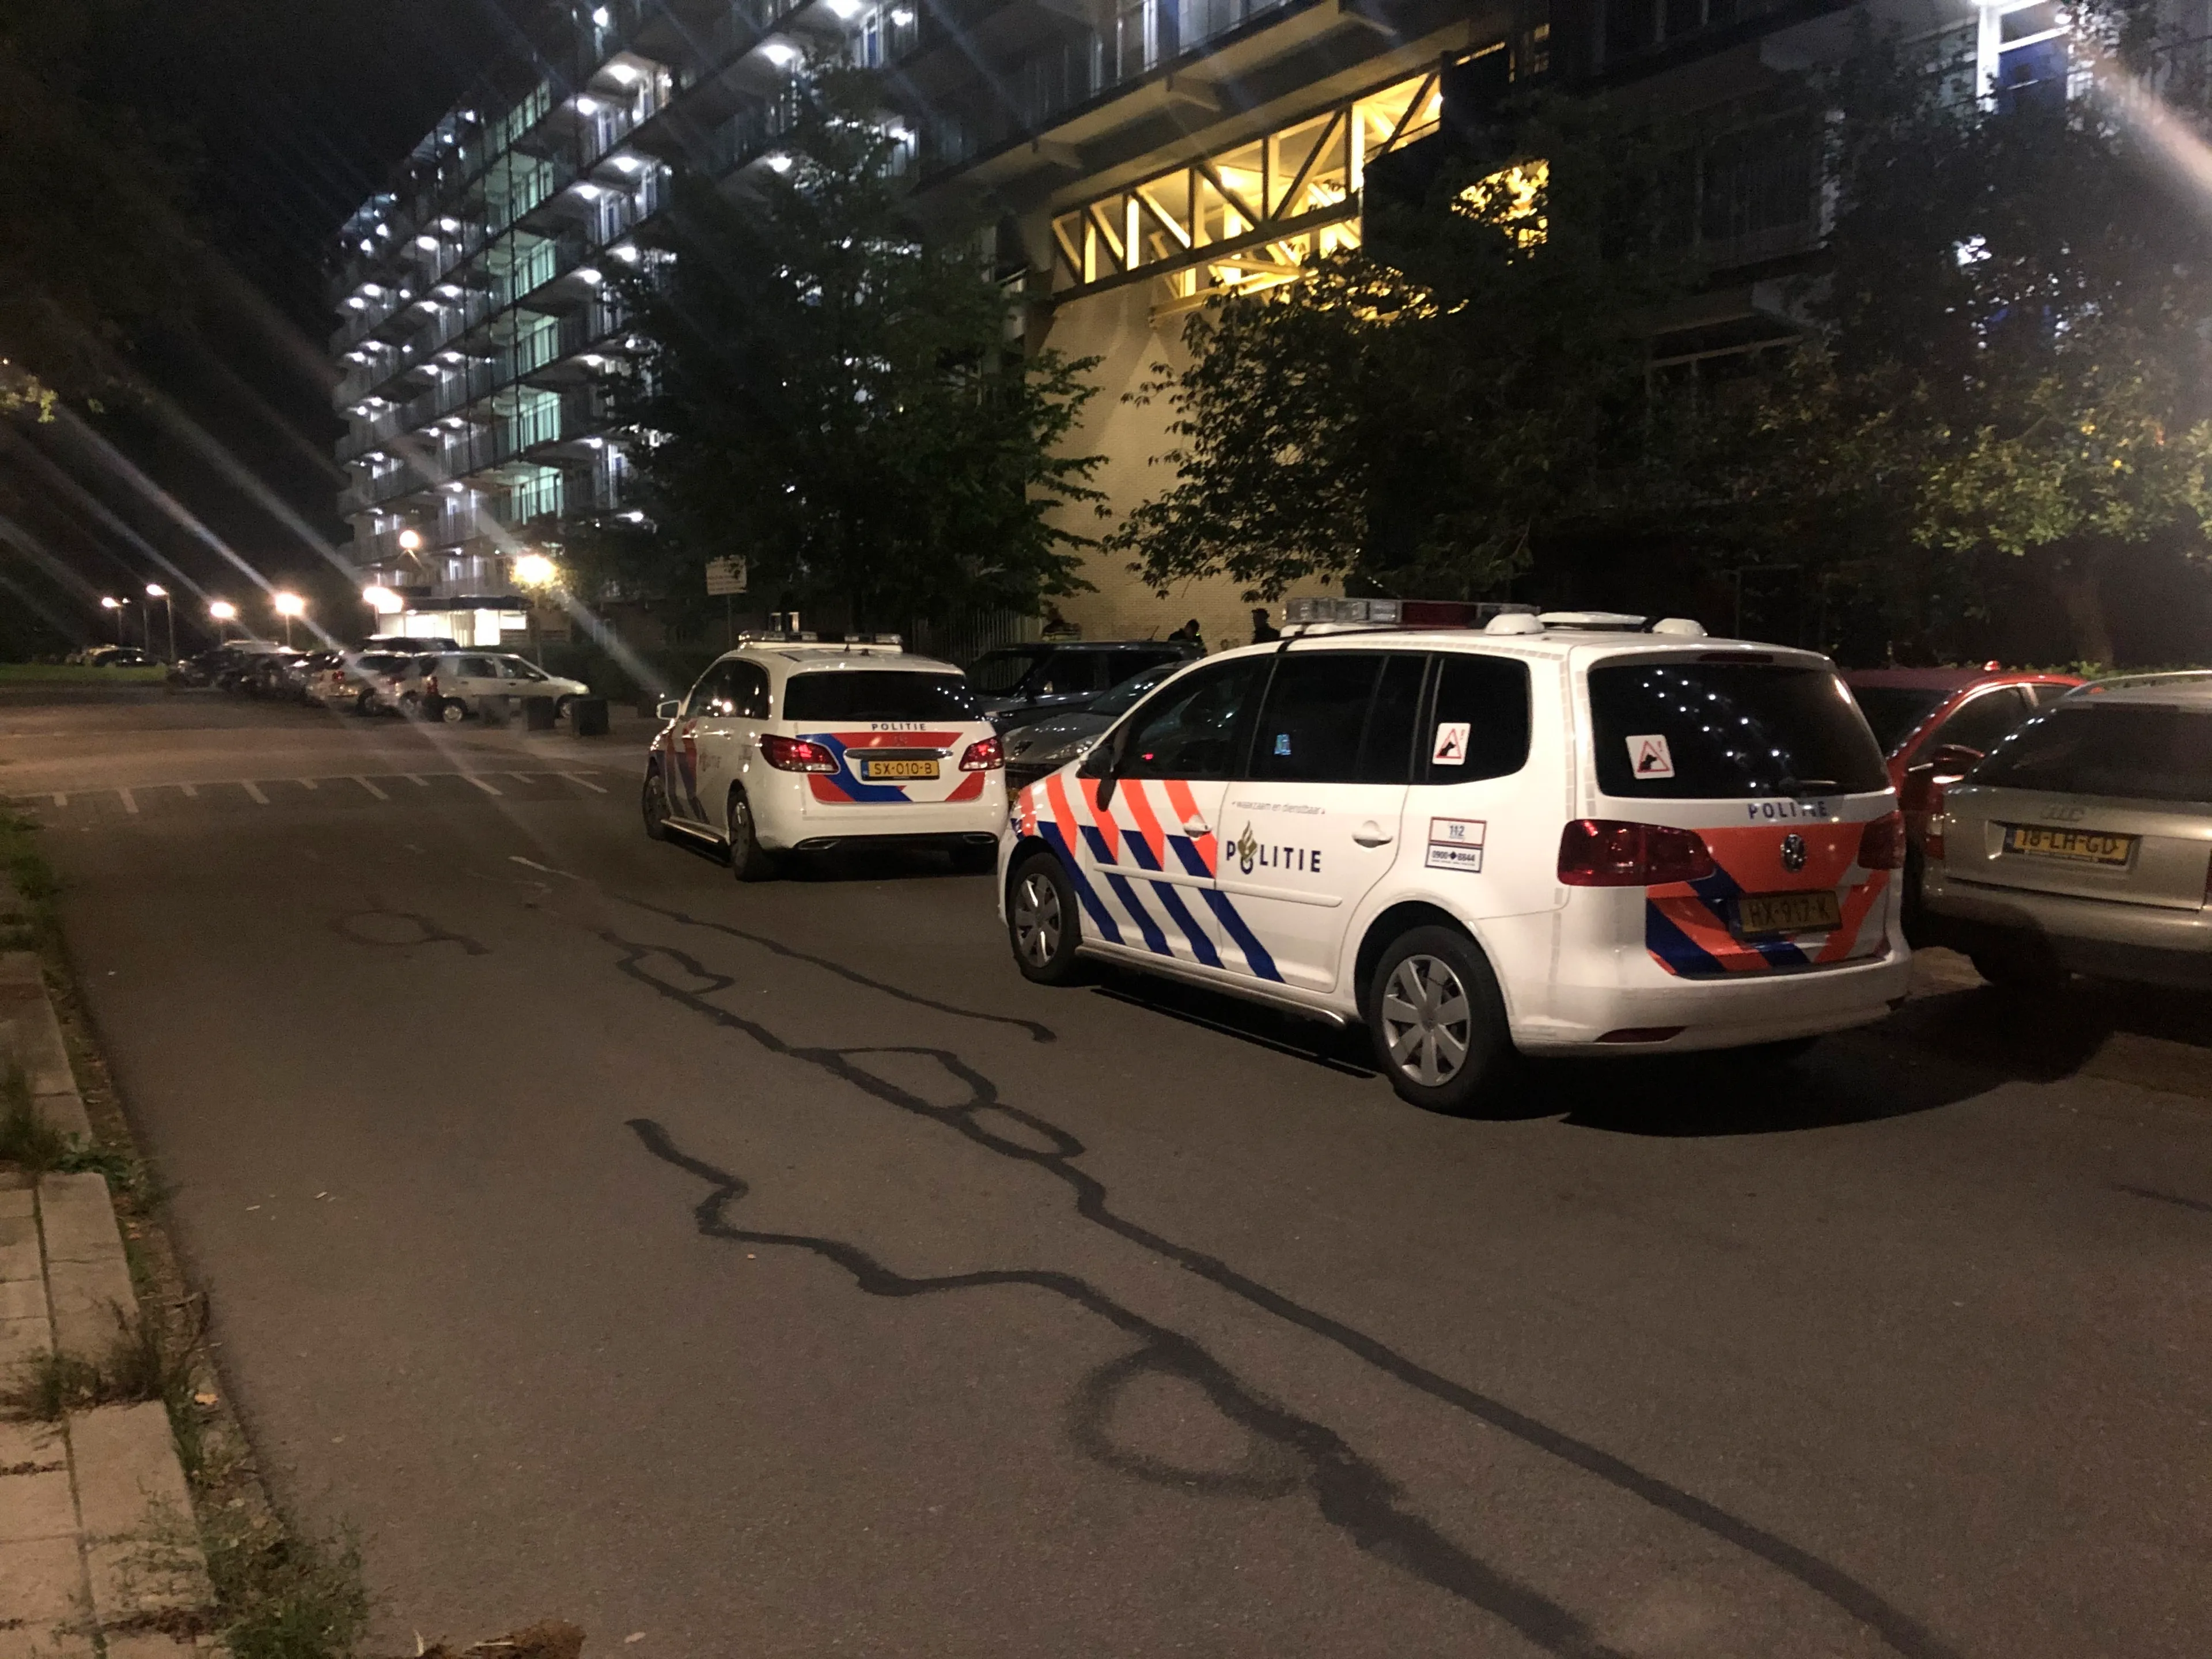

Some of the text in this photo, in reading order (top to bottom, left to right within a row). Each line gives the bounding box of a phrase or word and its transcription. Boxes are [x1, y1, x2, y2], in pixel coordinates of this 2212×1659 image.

[874, 762, 932, 775] SX-010-B
[1449, 825, 1465, 836] 112
[1226, 840, 1321, 875] POLITIE
